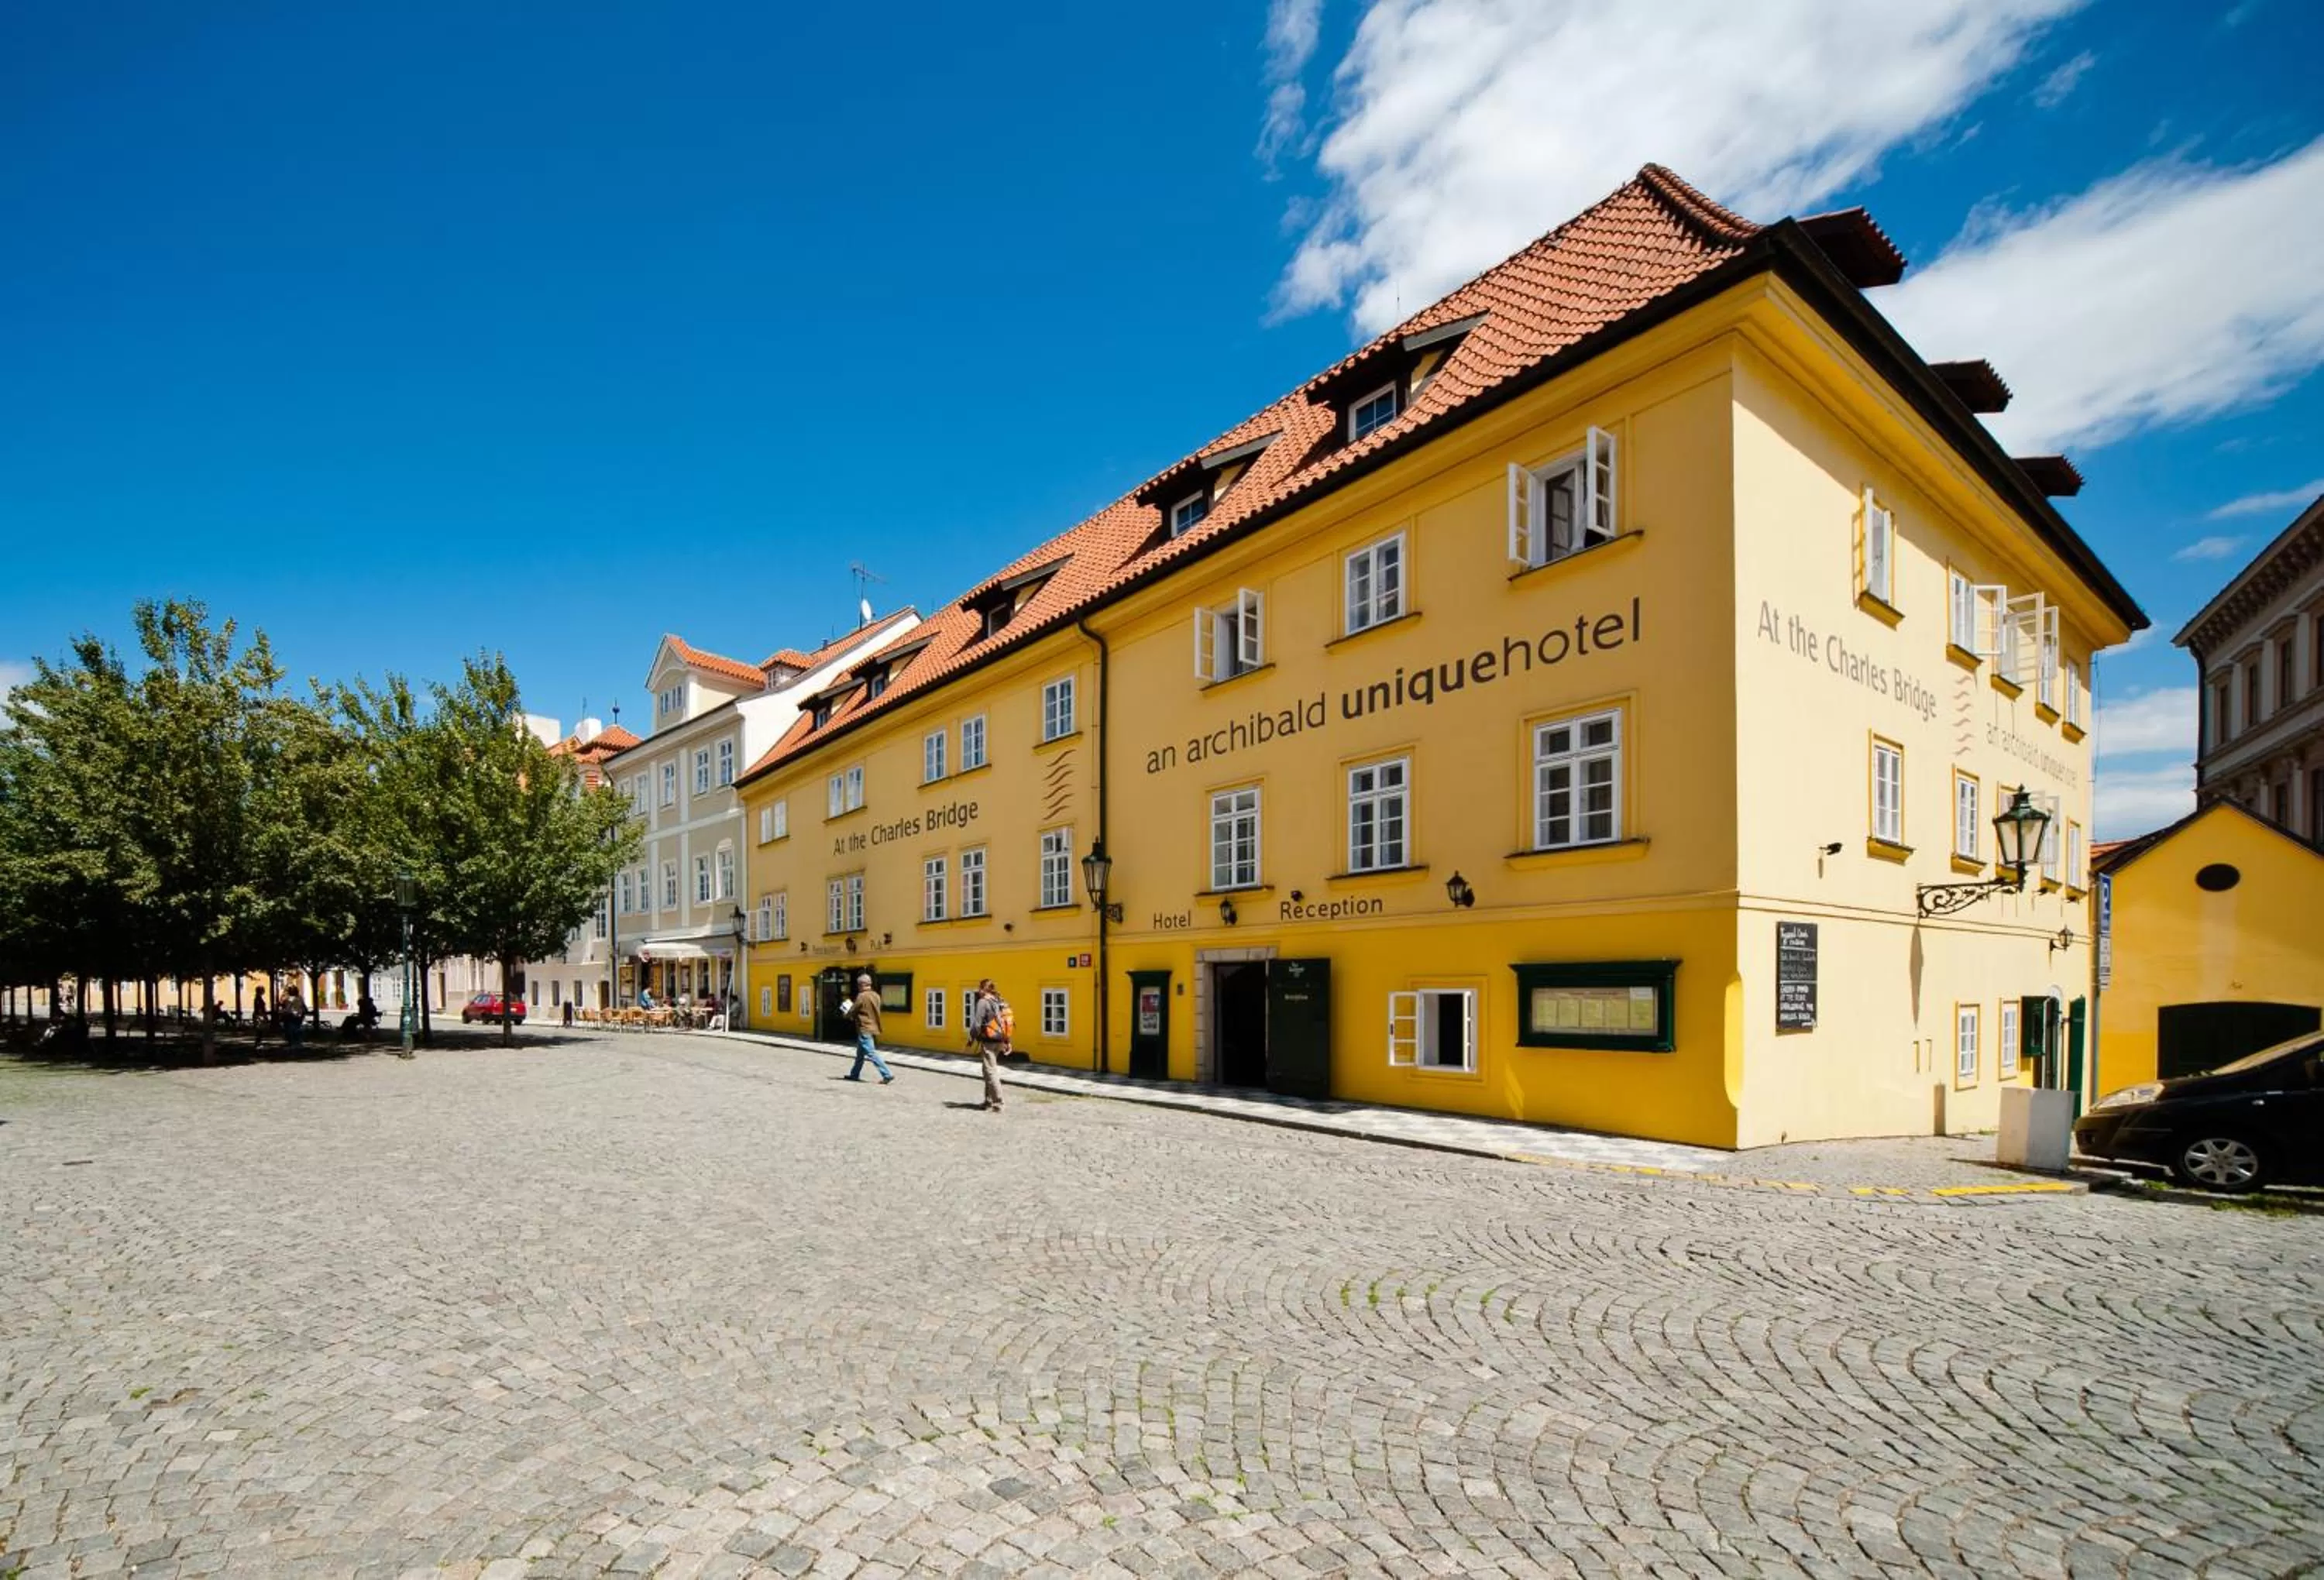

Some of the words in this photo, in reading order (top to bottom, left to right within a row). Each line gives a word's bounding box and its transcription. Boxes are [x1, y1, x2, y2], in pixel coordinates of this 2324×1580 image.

[1758, 600, 1781, 645] At
[1787, 615, 1818, 663] the
[1826, 635, 1888, 695] Charles
[1894, 668, 1937, 722] Bridge
[1147, 746, 1176, 774] an
[1187, 692, 1325, 764] archibald
[833, 838, 846, 856] At
[847, 833, 866, 852] the
[871, 818, 920, 846] Charles
[927, 802, 978, 831] Bridge
[1153, 910, 1191, 929] Hotel
[1280, 896, 1383, 921] Reception
